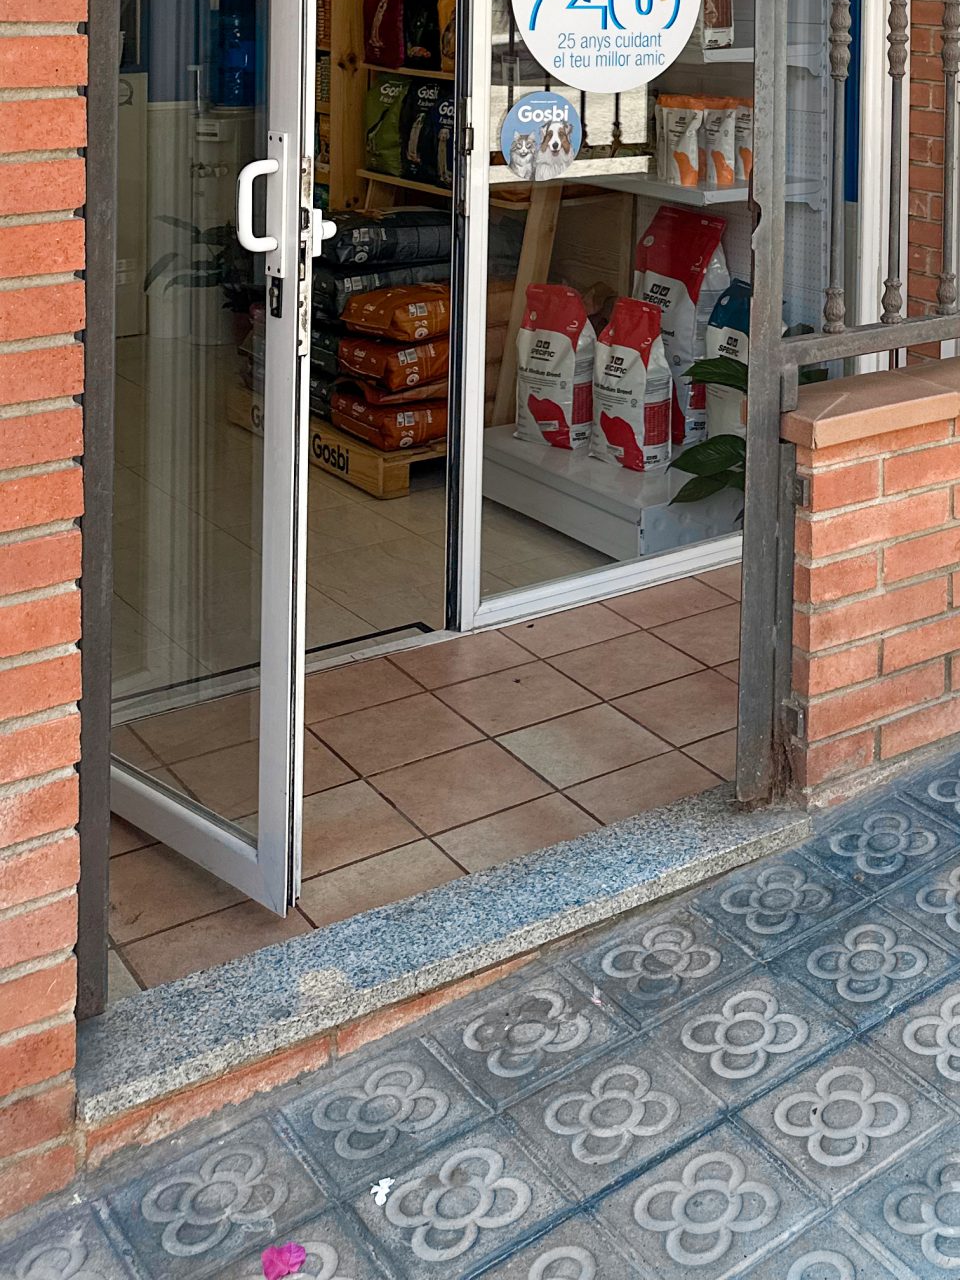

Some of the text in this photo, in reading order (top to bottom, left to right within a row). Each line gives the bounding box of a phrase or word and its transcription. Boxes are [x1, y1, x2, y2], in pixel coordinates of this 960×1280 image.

[557, 32, 662, 51] 25 anys cuidant
[553, 50, 665, 68] el teu millor amic
[517, 104, 569, 123] Gosbi
[312, 433, 350, 475] Gosbi
